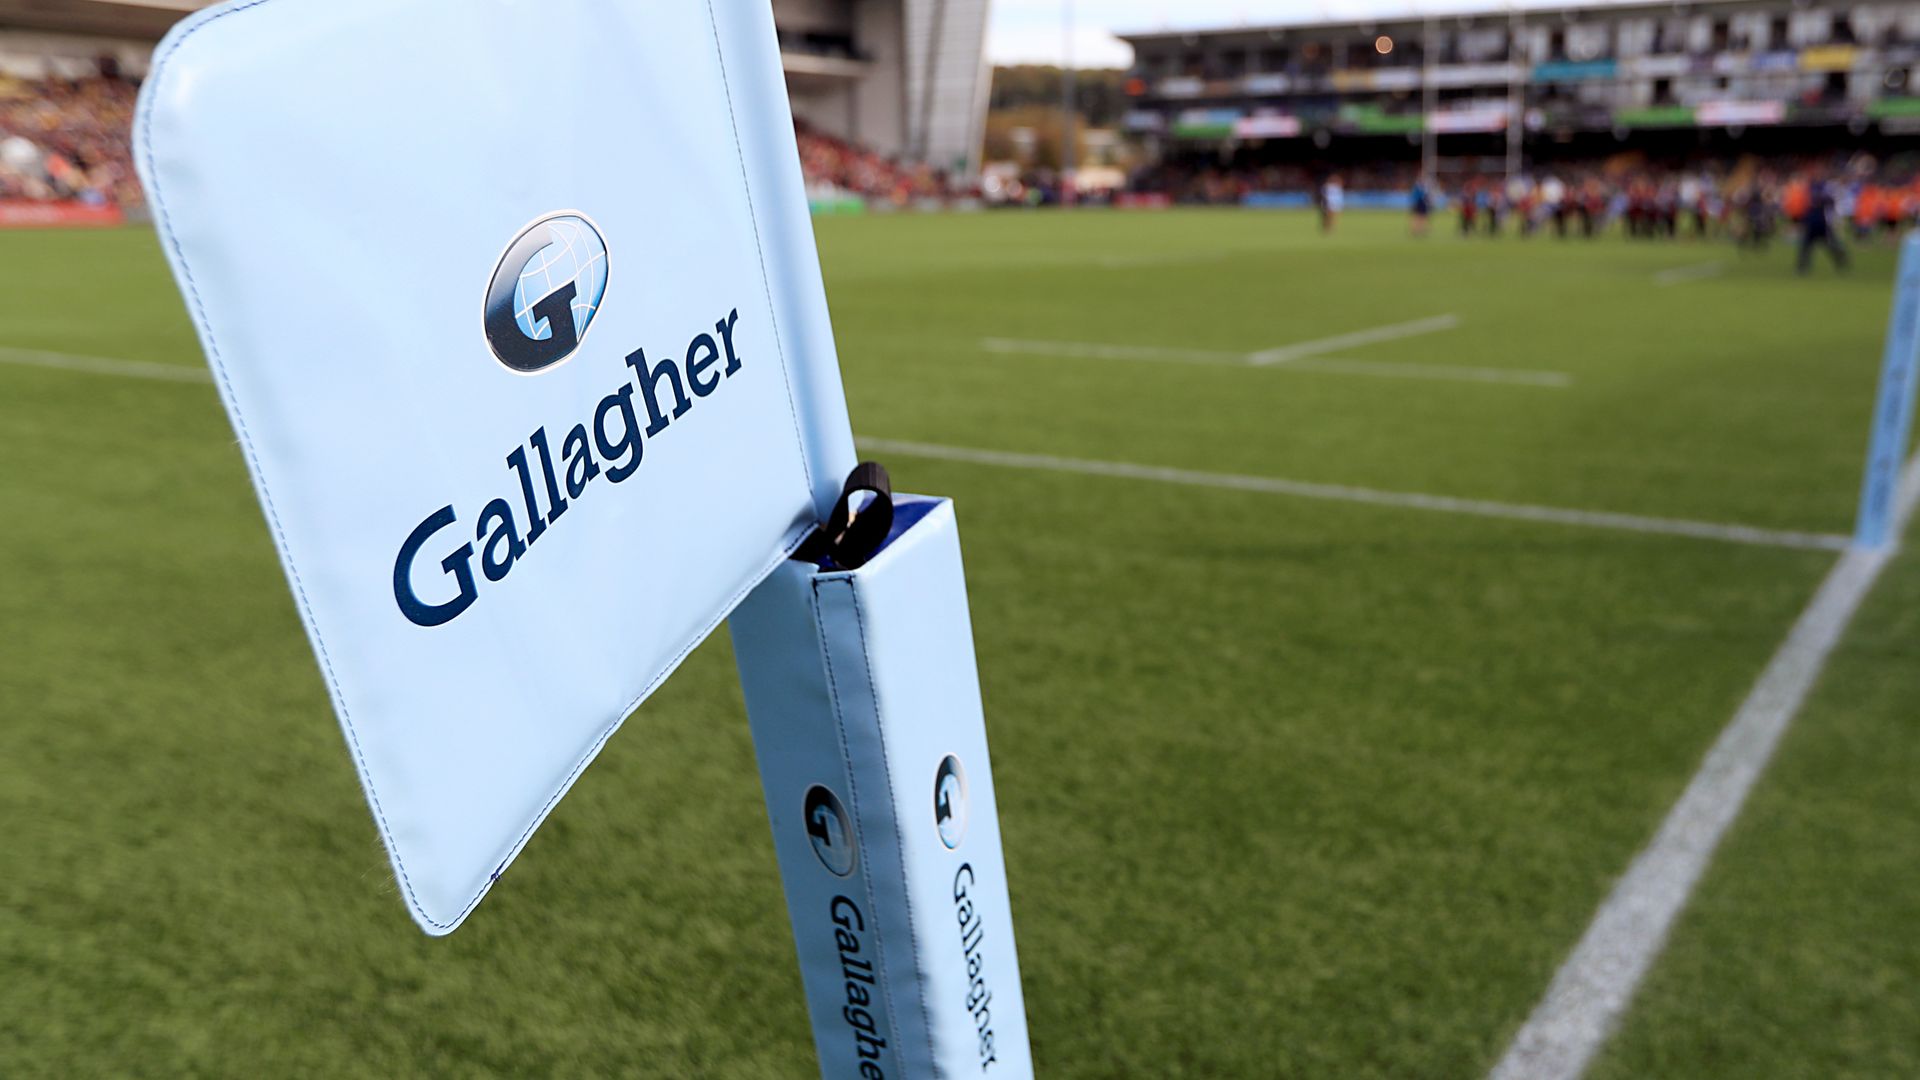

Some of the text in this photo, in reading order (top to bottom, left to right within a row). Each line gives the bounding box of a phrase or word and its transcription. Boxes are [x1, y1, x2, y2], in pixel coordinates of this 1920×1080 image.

[484, 219, 578, 372] G
[393, 307, 742, 627] Gallagher
[805, 785, 851, 847] G
[935, 755, 964, 825] G
[831, 895, 886, 1080] Gallaghe
[954, 862, 996, 1072] Gallagher
